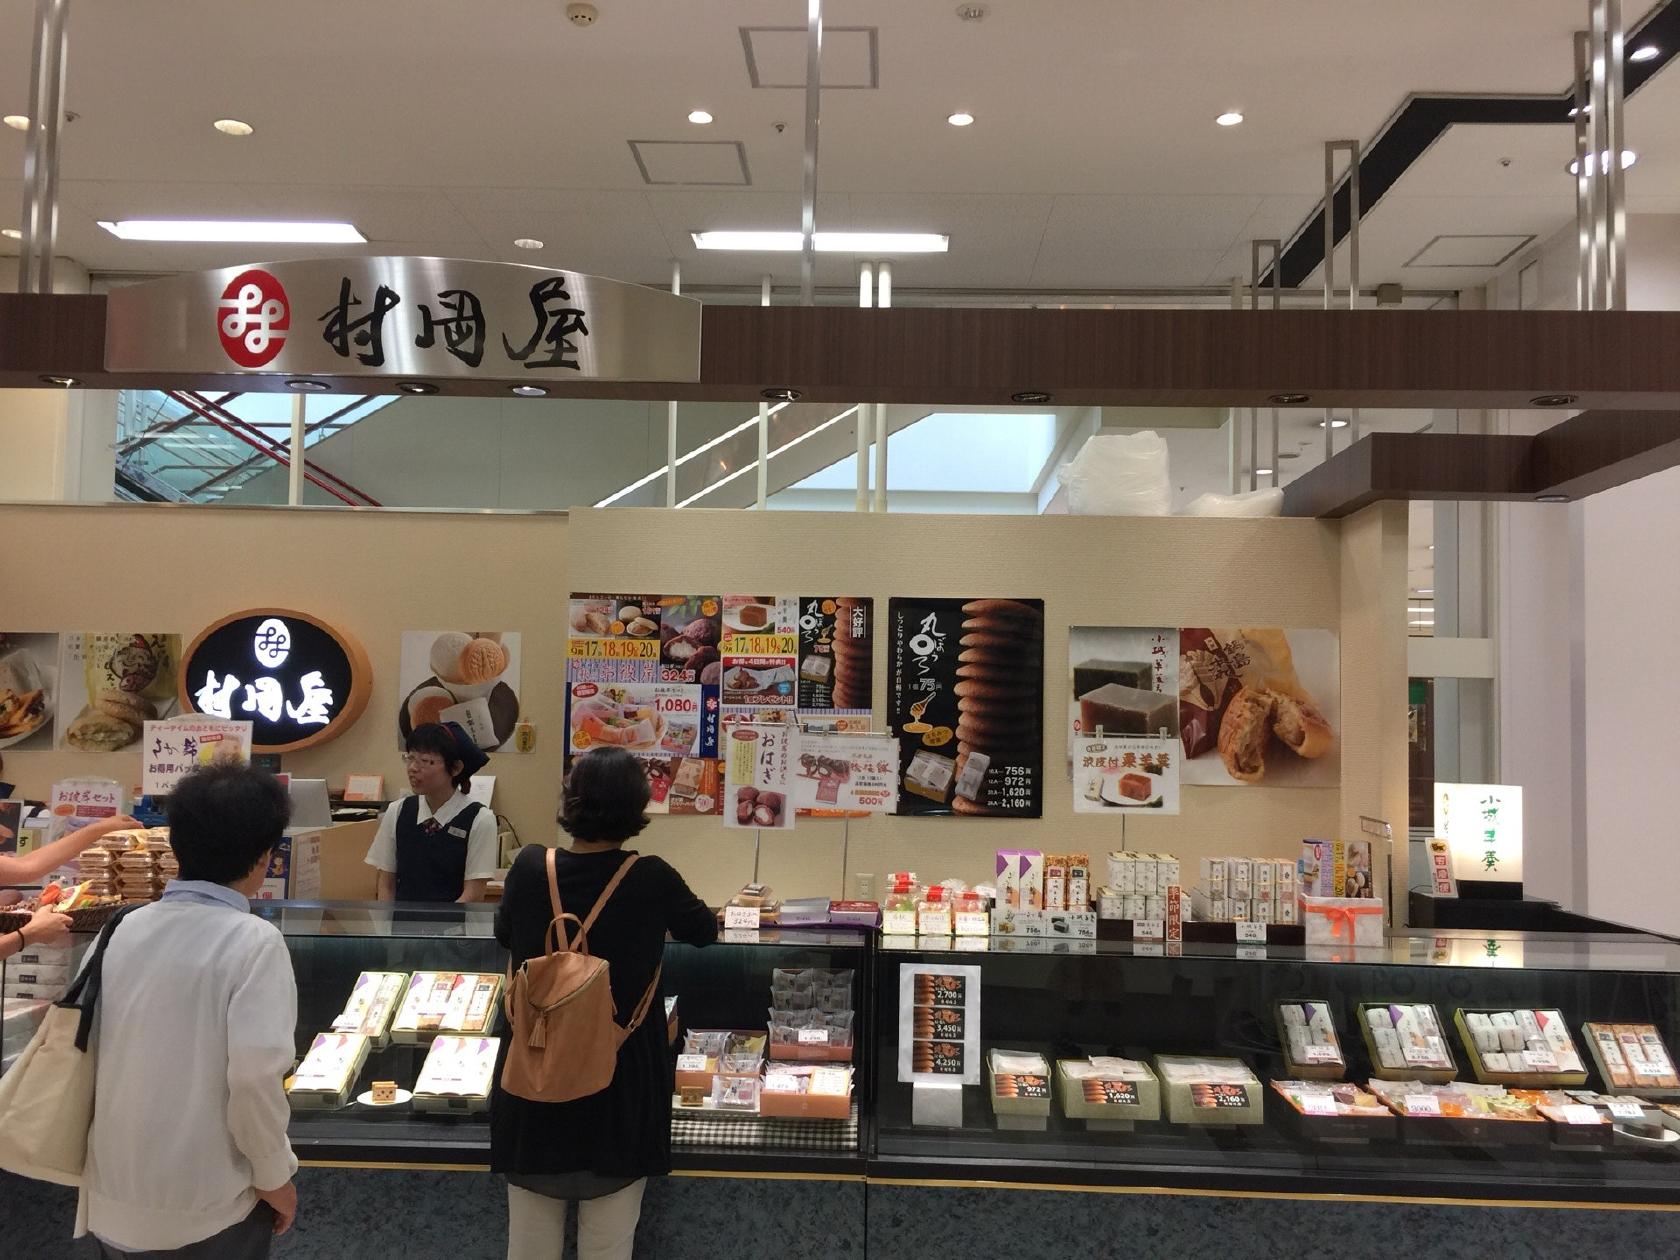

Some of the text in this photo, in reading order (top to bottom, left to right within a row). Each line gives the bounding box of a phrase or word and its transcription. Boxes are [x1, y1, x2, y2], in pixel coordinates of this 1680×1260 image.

[318, 276, 588, 370] 村岡屋
[194, 669, 334, 724] 村岡屋
[760, 732, 777, 785] おはぎ
